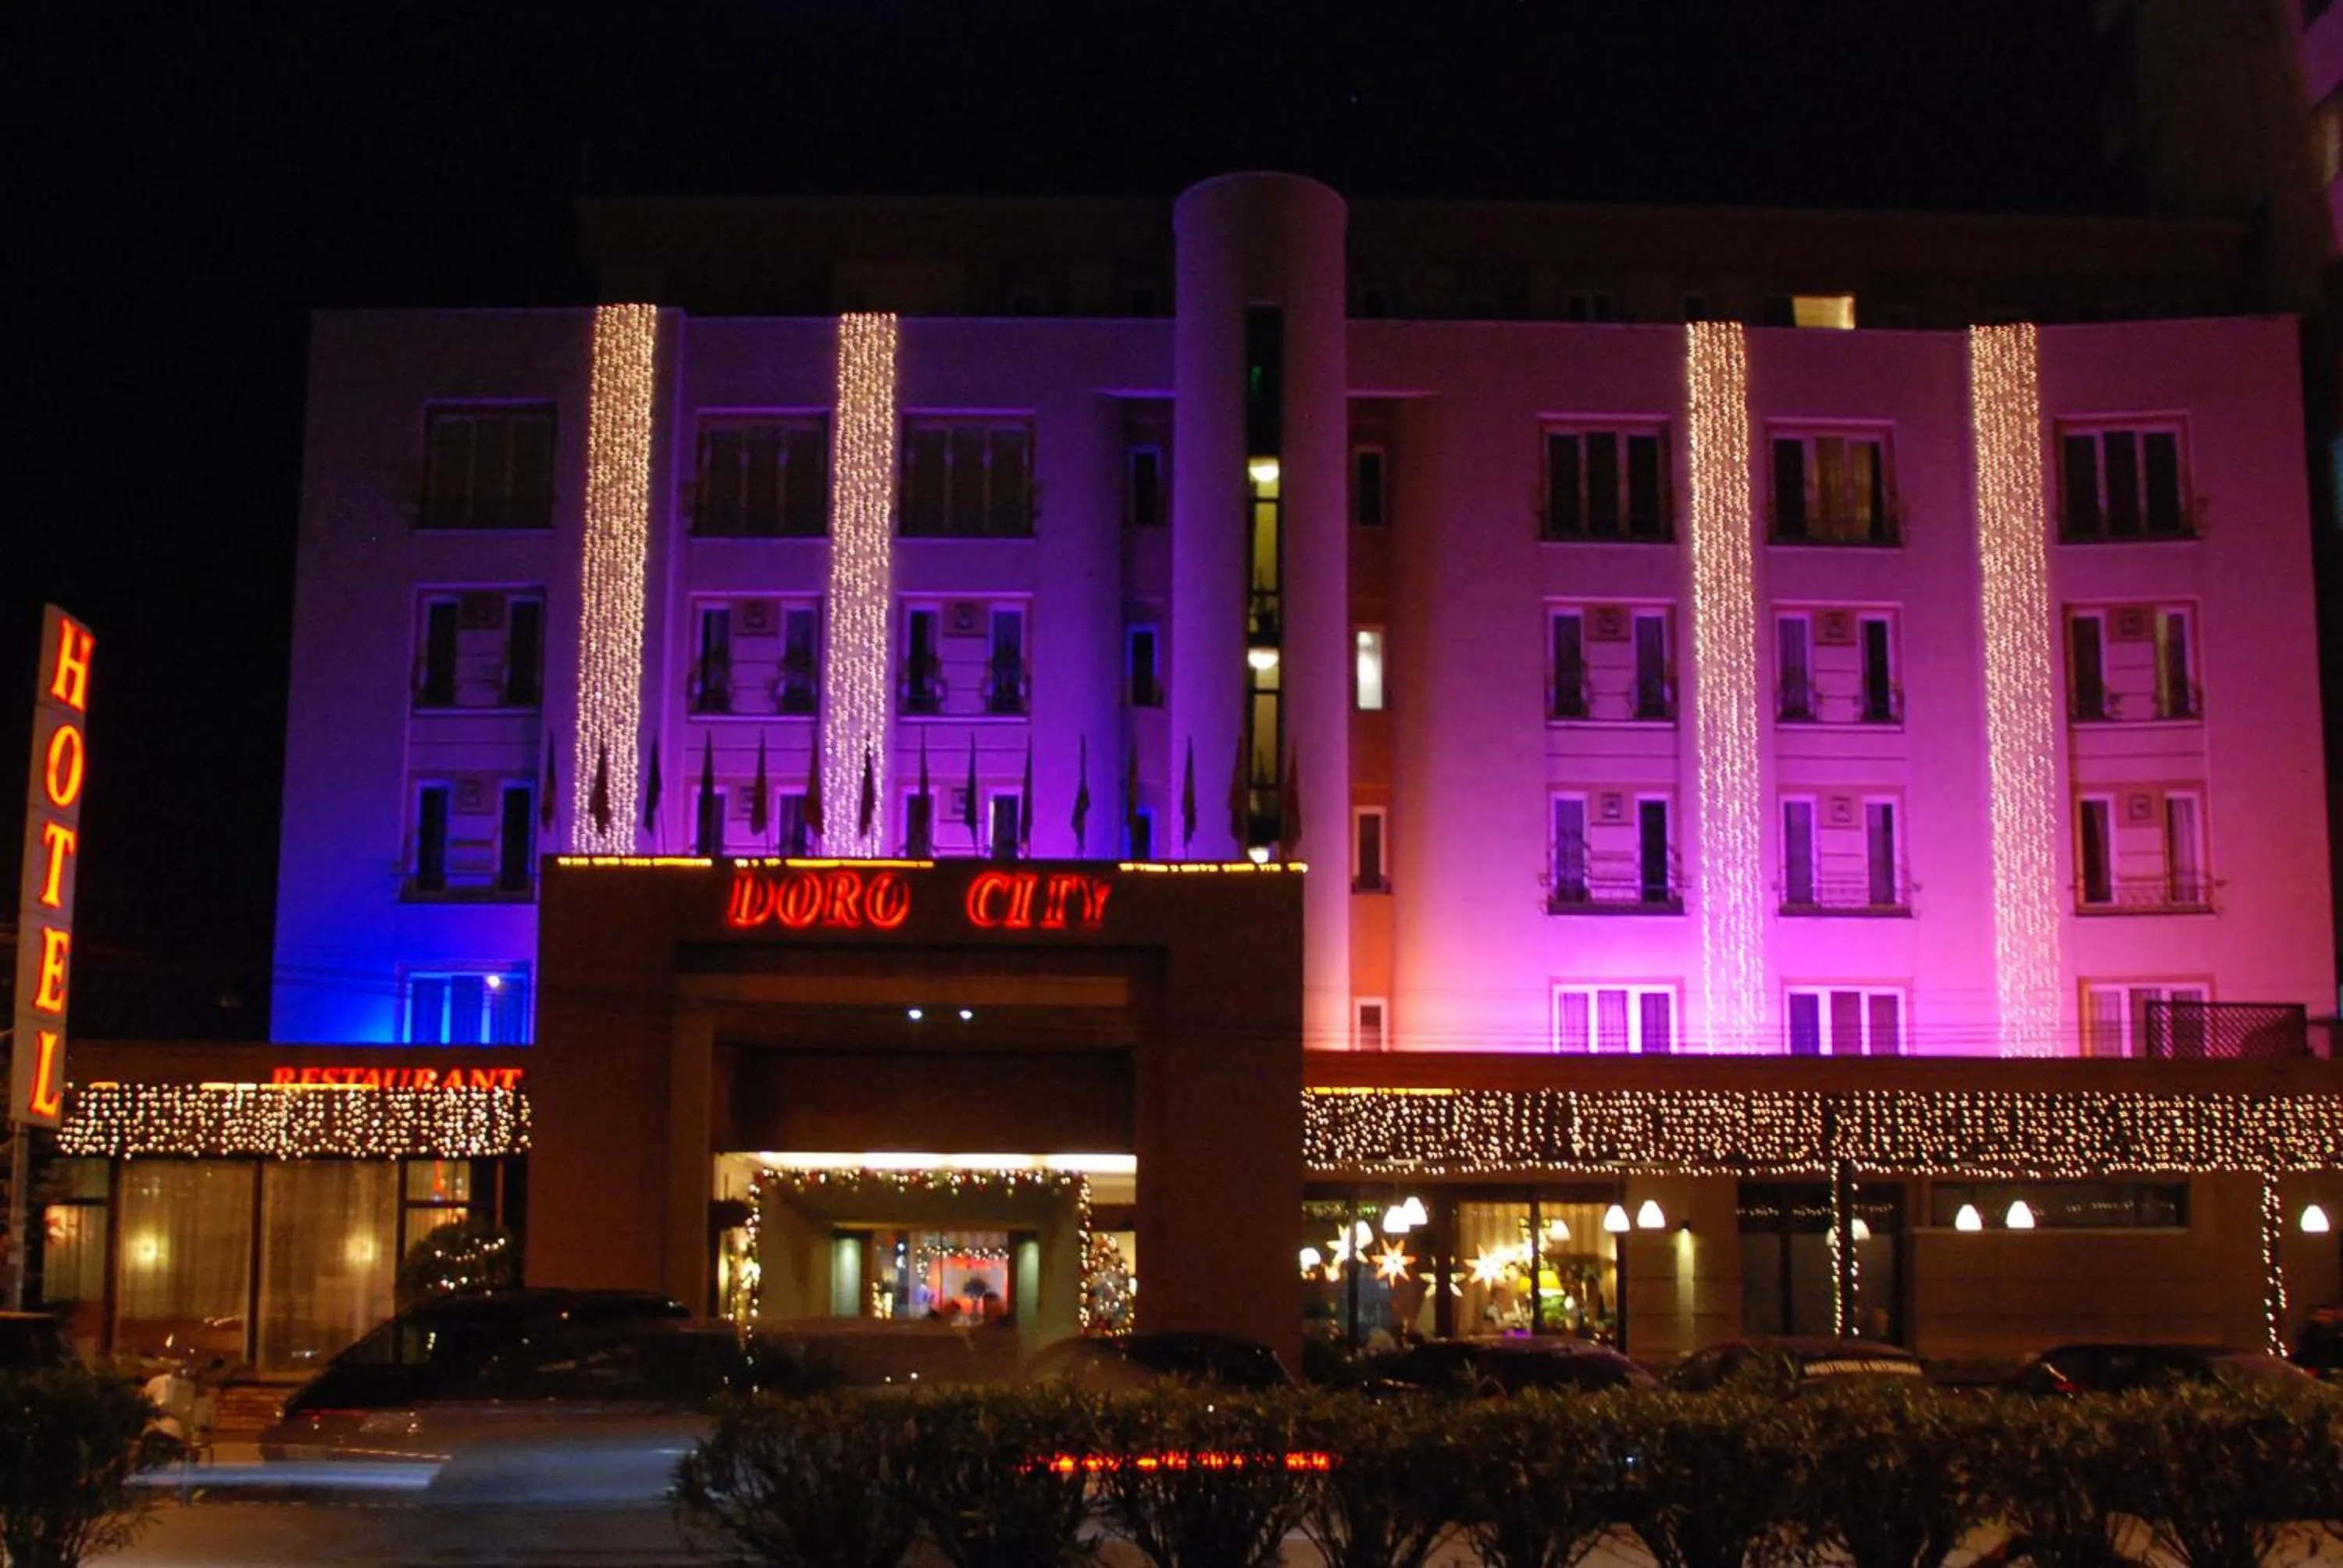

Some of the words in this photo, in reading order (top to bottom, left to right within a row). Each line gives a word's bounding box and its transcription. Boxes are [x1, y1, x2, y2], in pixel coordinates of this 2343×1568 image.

[31, 618, 95, 1117] HOTEL
[727, 871, 911, 929] DORO
[965, 870, 1113, 929] CITY
[273, 1067, 524, 1091] RESTAURANT
